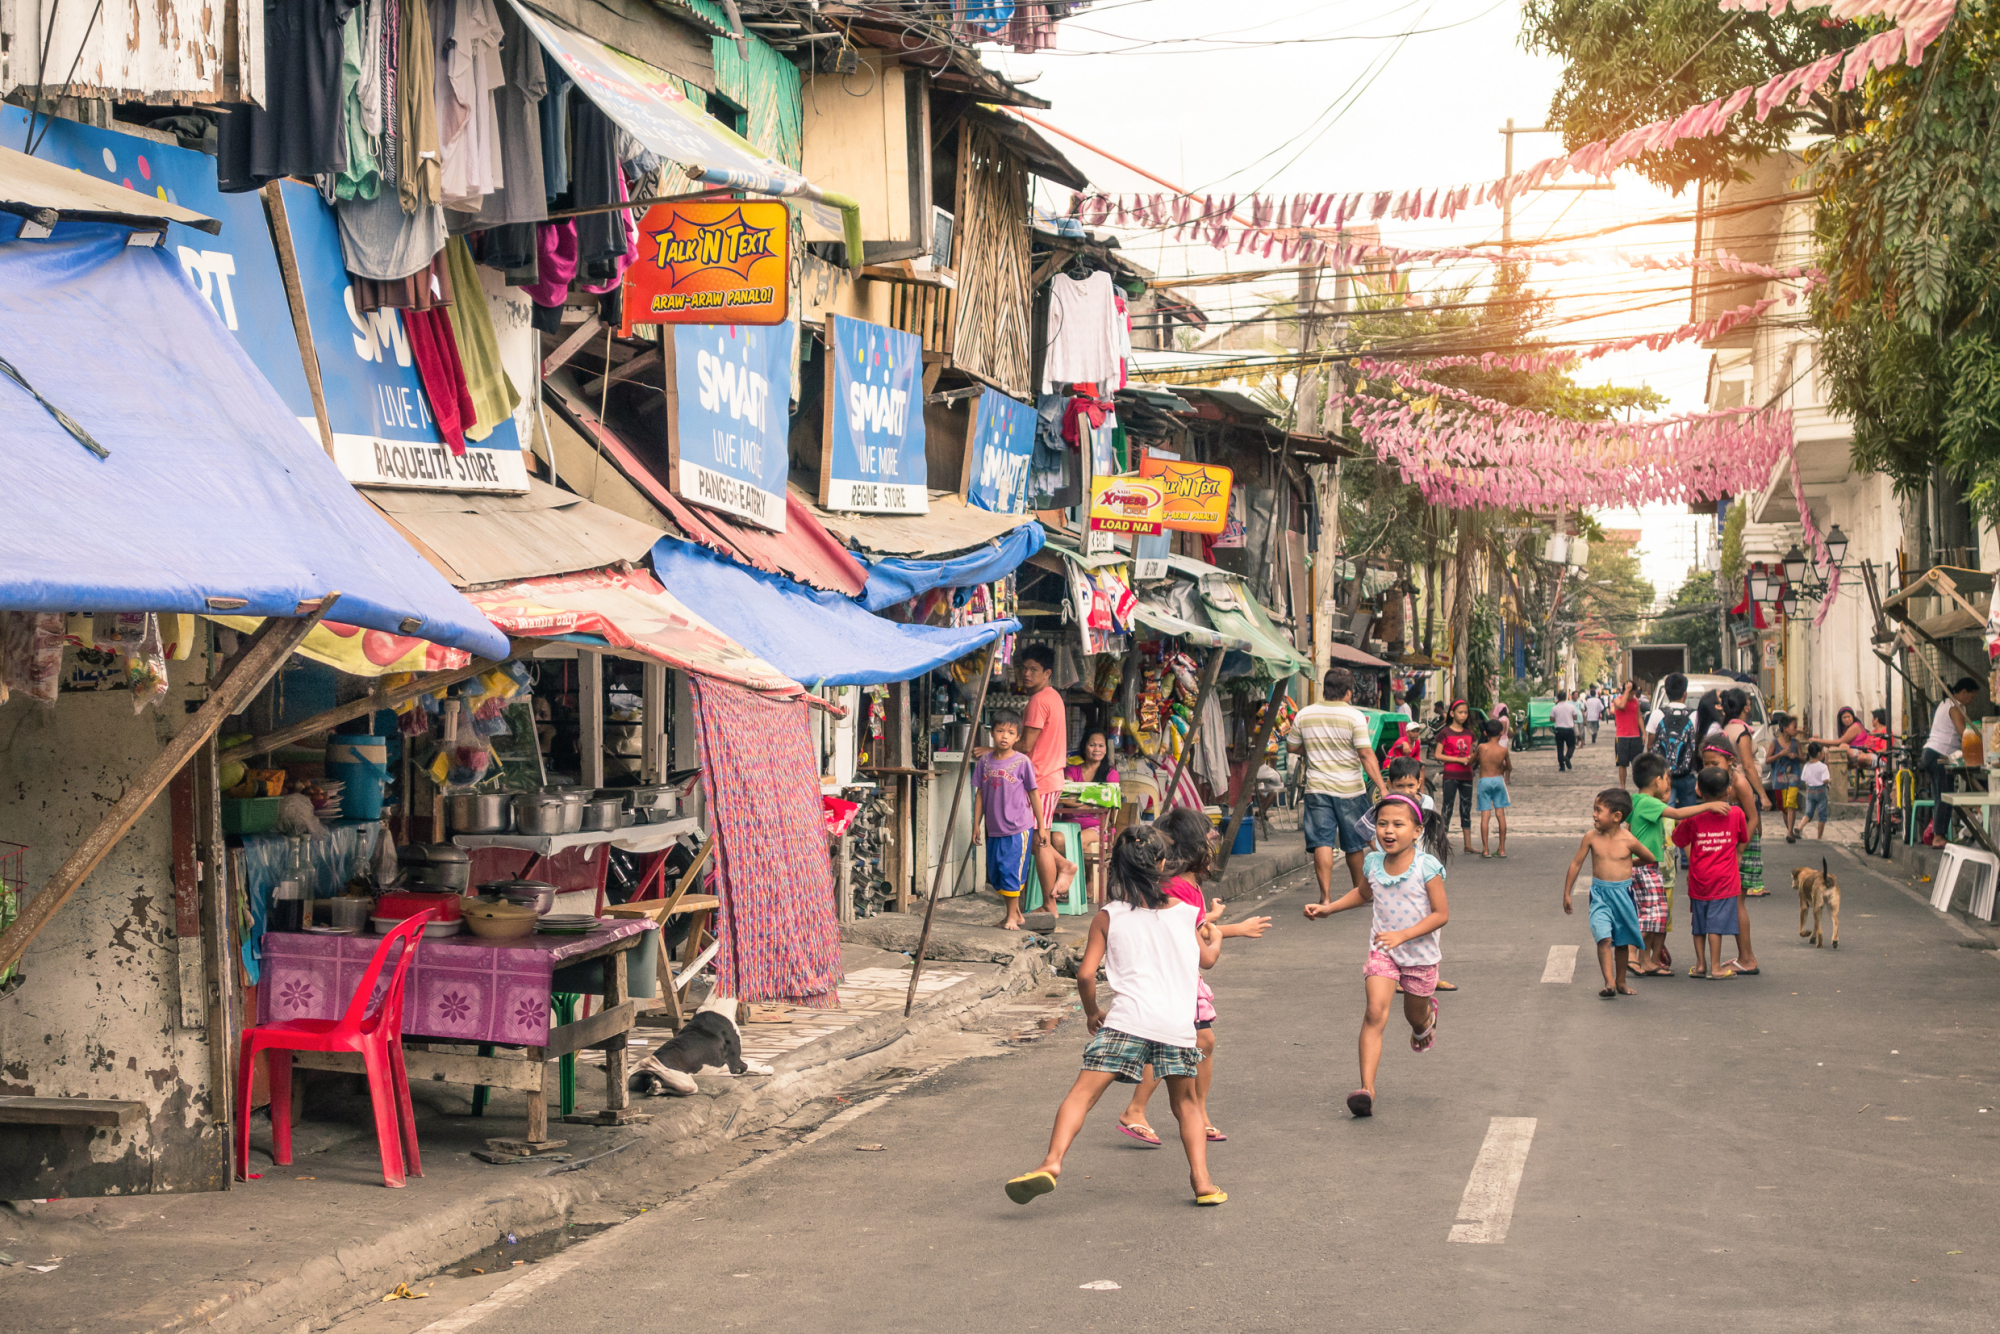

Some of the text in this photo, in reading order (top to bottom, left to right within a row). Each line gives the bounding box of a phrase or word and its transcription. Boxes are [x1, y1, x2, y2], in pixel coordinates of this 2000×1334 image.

[655, 230, 698, 270] TALK
[726, 225, 771, 263] TEXT
[652, 286, 774, 313] ARAW-ARAW PANALO!
[378, 383, 418, 430] LIVE
[697, 349, 768, 434] SMART
[850, 381, 907, 437] SMART
[373, 442, 500, 483] RAQUELITA STORE
[712, 428, 763, 480] LIVE MORE
[859, 445, 899, 477] LIVE MORE
[883, 486, 906, 508] STORE
[1194, 475, 1220, 497] TEXT
[1099, 519, 1154, 533] LOAD NA!
